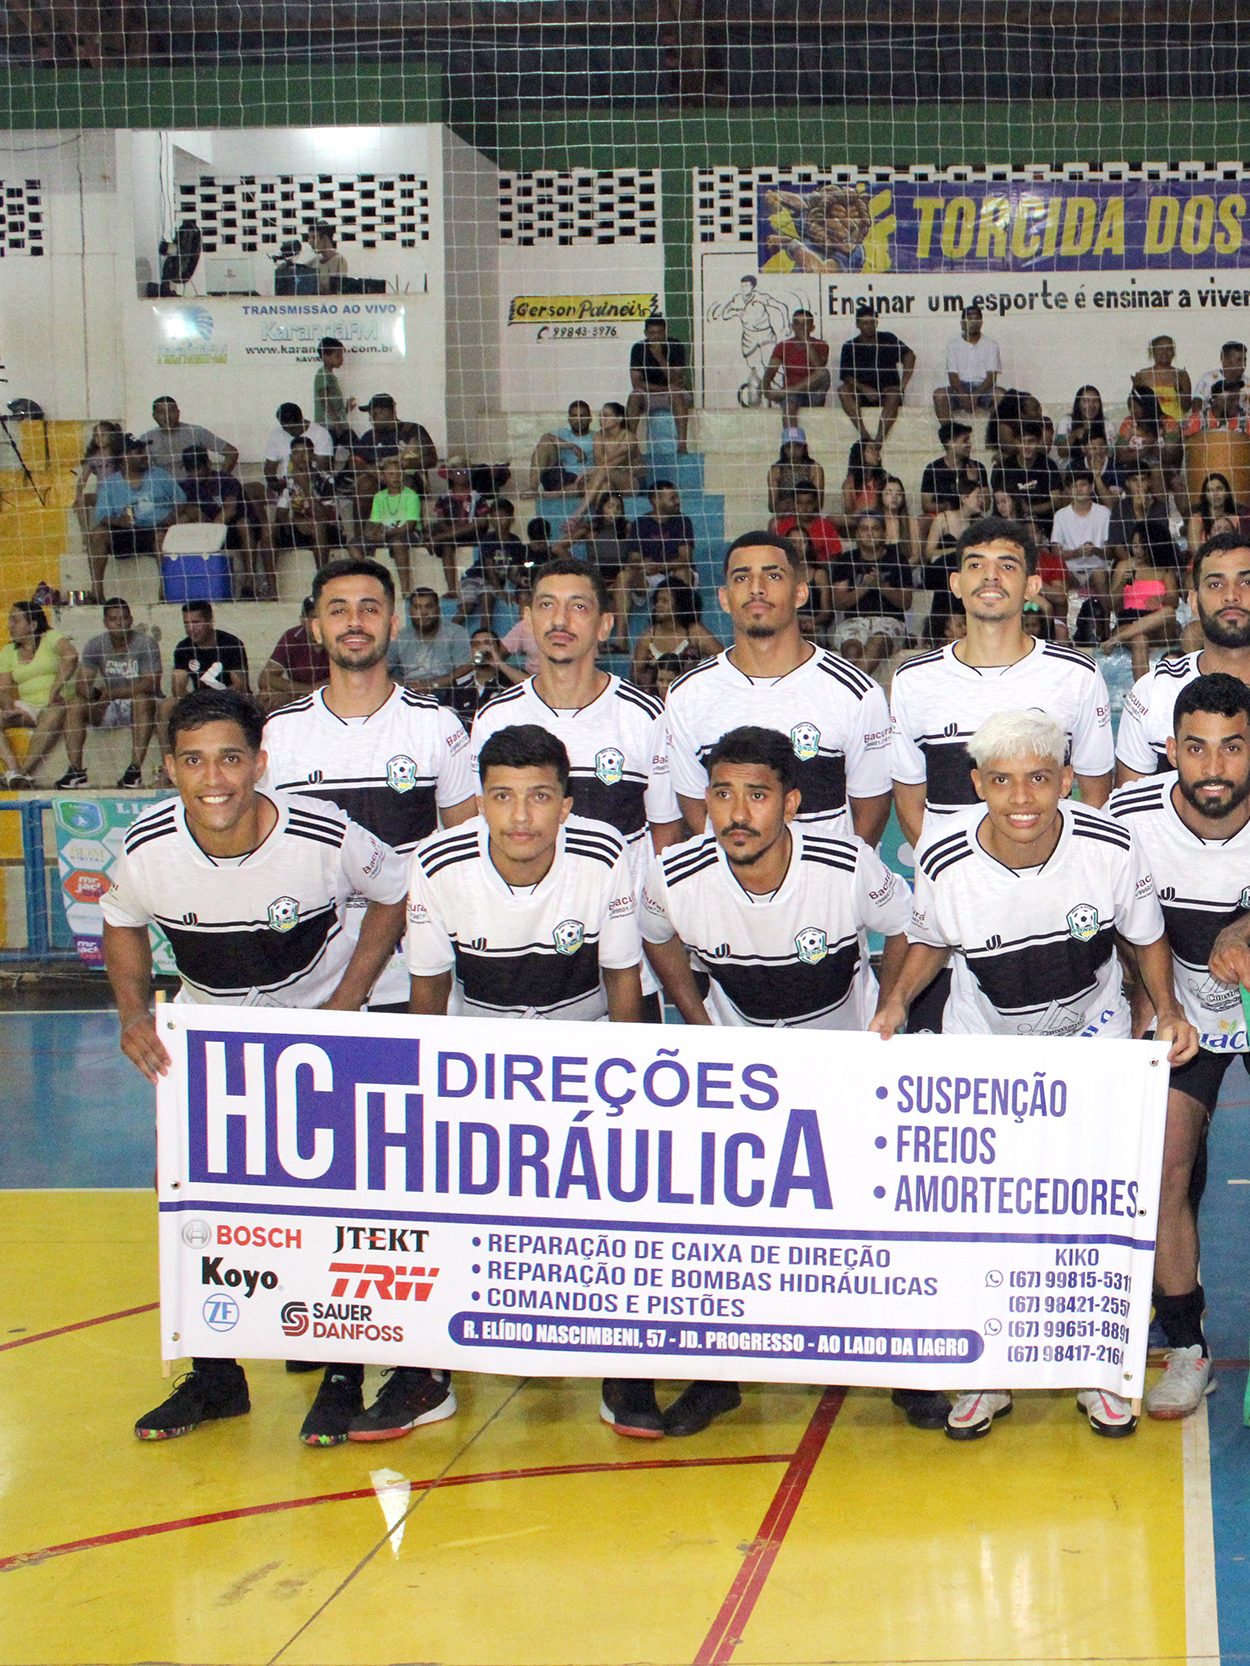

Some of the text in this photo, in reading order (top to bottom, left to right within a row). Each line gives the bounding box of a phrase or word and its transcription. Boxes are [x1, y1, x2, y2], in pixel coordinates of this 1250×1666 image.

[913, 195, 1126, 258] TORCIDA
[1143, 193, 1247, 254] DOS
[243, 303, 397, 315] TRANSMISSÃO AO VIVO
[516, 302, 575, 317] Gerson
[828, 284, 915, 315] Ensinar
[928, 294, 963, 312] um
[972, 279, 1069, 316] esporte
[1074, 284, 1086, 309] é
[1093, 277, 1174, 309] ensinar
[1178, 289, 1191, 308] a
[437, 1048, 780, 1117] DIREÇÕES
[897, 1071, 1067, 1123] SUSPENÇÃO
[205, 1040, 335, 1180] HC
[367, 1091, 834, 1210] HIDRÁULICA
[896, 1125, 996, 1165] FREIOS
[894, 1175, 1139, 1218] AMORTECEDORES
[217, 1225, 301, 1249] BOSCH
[332, 1226, 429, 1254] JTEKT
[488, 1233, 891, 1270] REPARAÇÃO DE CAIXA DE DIREÇÃO
[1055, 1248, 1100, 1266] KIKO
[201, 1256, 279, 1298] Koyo
[328, 1262, 441, 1302] TRW
[487, 1260, 938, 1296] REPARAÇÃO DE BOMBAS HIDRÁULICAS
[1009, 1271, 1041, 1288] (67)
[208, 1301, 233, 1325] ZF
[312, 1303, 373, 1322] SAUER
[487, 1287, 745, 1318] COMANDOS E PISTÕES
[1009, 1295, 1041, 1313] (67)
[312, 1323, 404, 1343] DANFOSS
[464, 1320, 479, 1340] R.
[482, 1318, 533, 1343] ELÍDIO
[536, 1324, 644, 1349] NASCIMBENI,
[647, 1329, 667, 1348] 57
[680, 1331, 703, 1350] JD.
[706, 1332, 804, 1353] PROGRESSO
[818, 1335, 839, 1354] AO
[844, 1336, 889, 1355] LADO
[891, 1337, 914, 1356] DA
[917, 1337, 970, 1357] IAGRO
[1008, 1320, 1040, 1338] (67)
[1007, 1345, 1039, 1363] (67)
